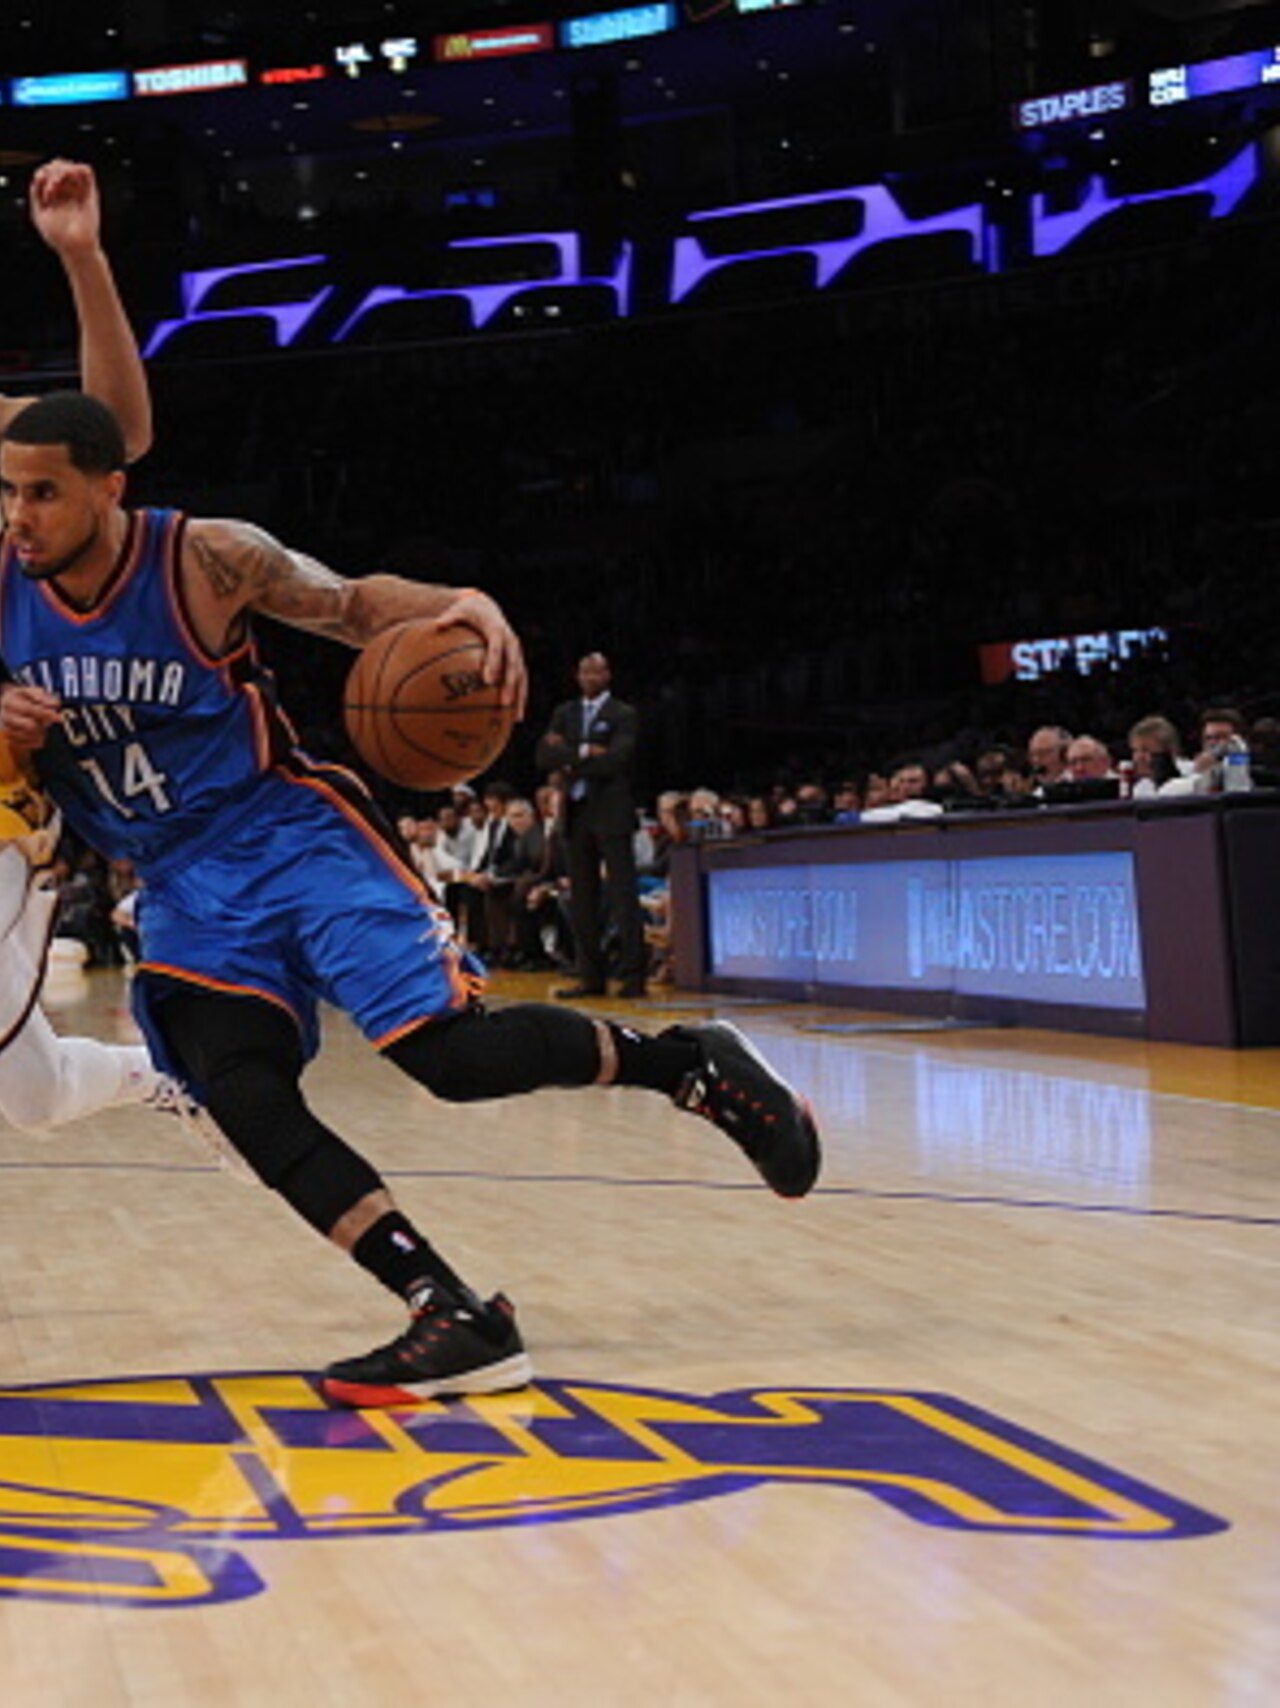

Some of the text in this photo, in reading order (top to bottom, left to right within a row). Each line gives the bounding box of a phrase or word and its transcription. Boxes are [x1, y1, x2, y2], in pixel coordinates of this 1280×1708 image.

[135, 62, 247, 95] TOSHIBA
[1020, 81, 1125, 127] STAPLES
[61, 704, 135, 746] CITY
[78, 743, 171, 818] 14
